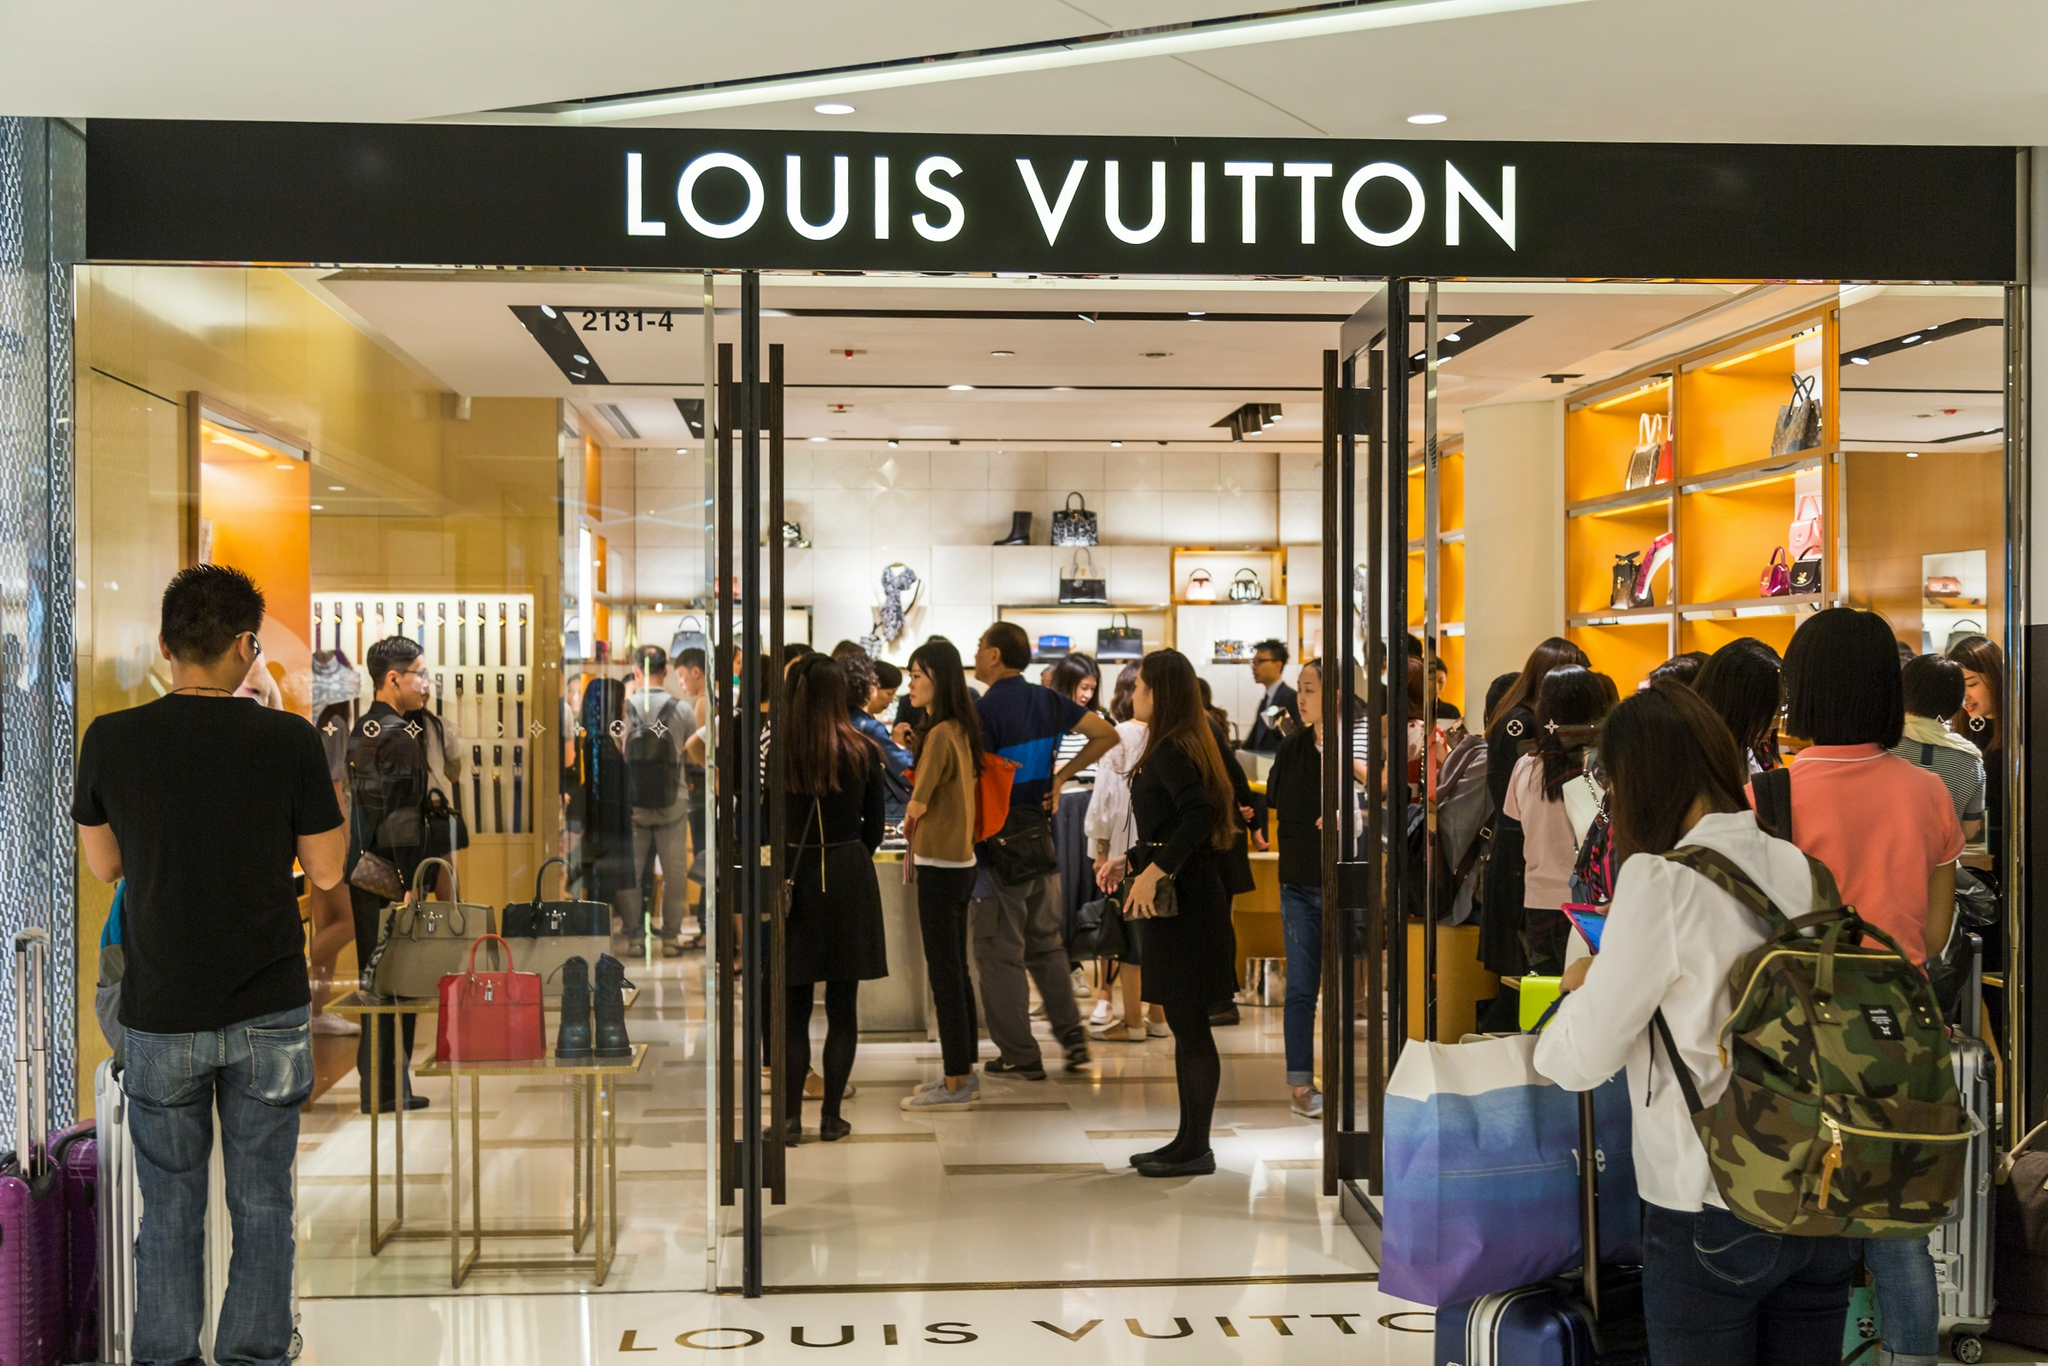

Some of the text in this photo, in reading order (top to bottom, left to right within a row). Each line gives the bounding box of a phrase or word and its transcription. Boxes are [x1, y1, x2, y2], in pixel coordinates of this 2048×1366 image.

[626, 152, 1517, 252] LOUIS VUITTON
[582, 309, 674, 332] 2131-4
[618, 1311, 1436, 1352] LOUIS VUITTO
